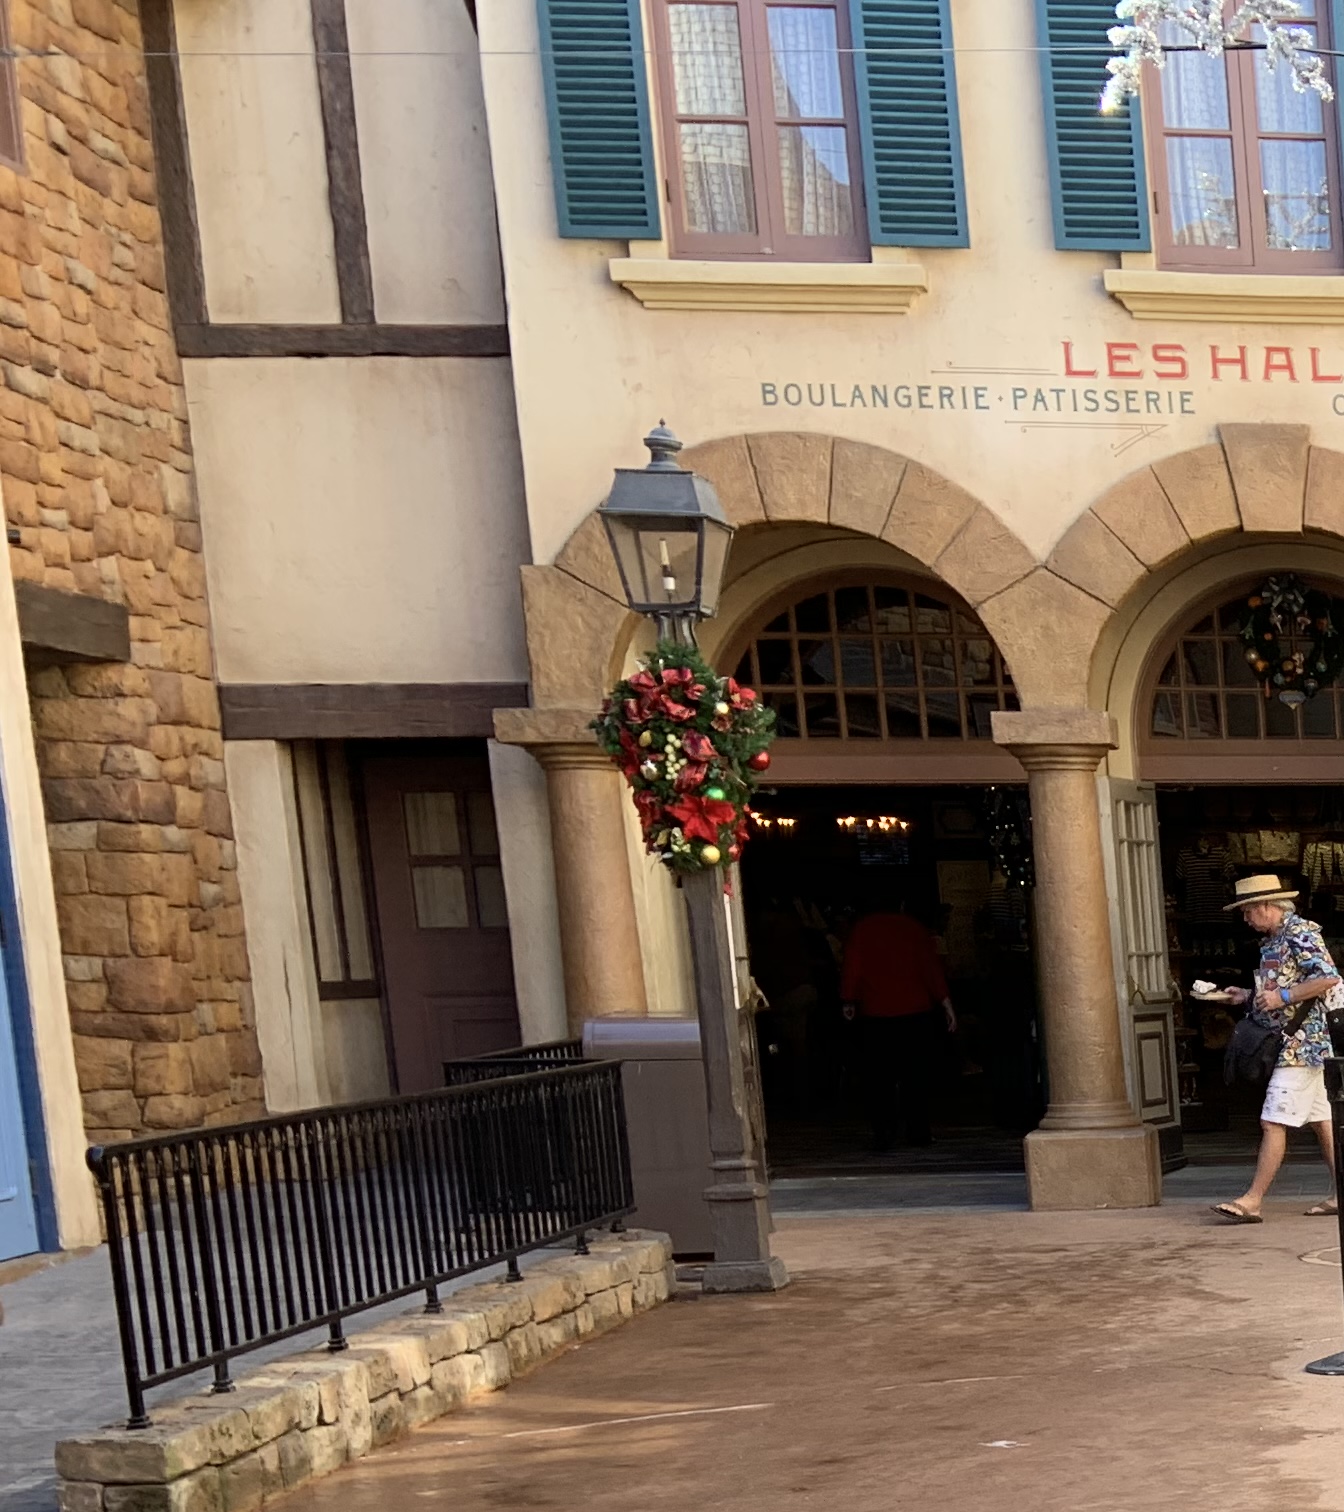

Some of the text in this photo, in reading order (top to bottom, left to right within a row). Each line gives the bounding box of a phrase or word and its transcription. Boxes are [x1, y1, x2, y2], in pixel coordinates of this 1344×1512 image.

[1062, 340, 1190, 379] LES
[762, 382, 1196, 415] BOULANGERIE PATISSERIE
